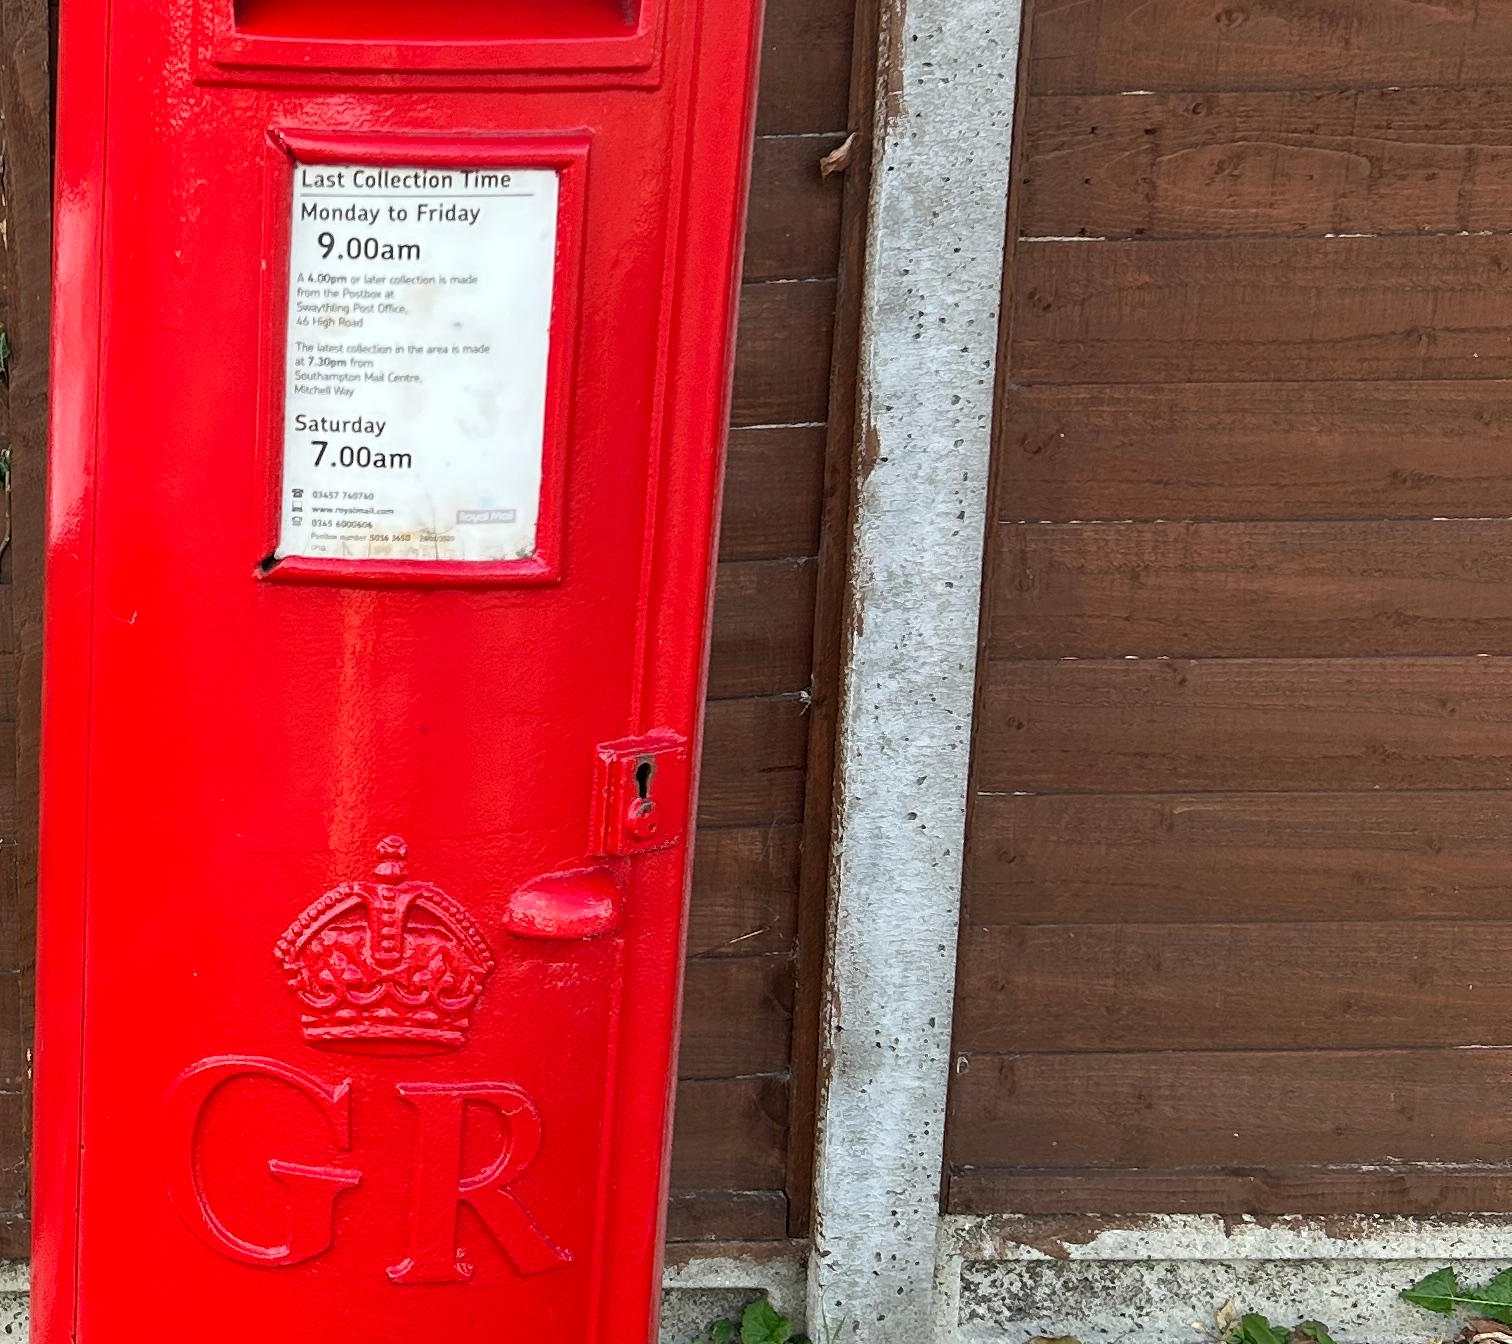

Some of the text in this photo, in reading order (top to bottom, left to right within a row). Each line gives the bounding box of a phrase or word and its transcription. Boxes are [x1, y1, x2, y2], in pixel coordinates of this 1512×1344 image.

[301, 169, 512, 189] Last Collection Time
[301, 202, 481, 225] Monday to Friday
[317, 231, 421, 260] 9.00am
[307, 273, 347, 286] 4.00pm
[350, 276, 360, 284] or
[364, 273, 386, 284] later
[389, 274, 435, 285] collection
[439, 274, 447, 285] is
[450, 273, 478, 285] made
[296, 287, 394, 299] from the Postbox at
[296, 301, 350, 315] Swaythling
[353, 302, 375, 313] Post
[296, 316, 364, 329] 46 High Road
[296, 341, 490, 354] The latest collection in the area is made
[294, 356, 374, 369] at 7.30pm from
[295, 370, 361, 383] Southampton
[364, 372, 384, 382] Mail
[294, 385, 355, 399] Mitchell Way
[294, 414, 387, 438] Saturday
[310, 440, 412, 469] 7.00am
[160, 1053, 575, 1286] GR
